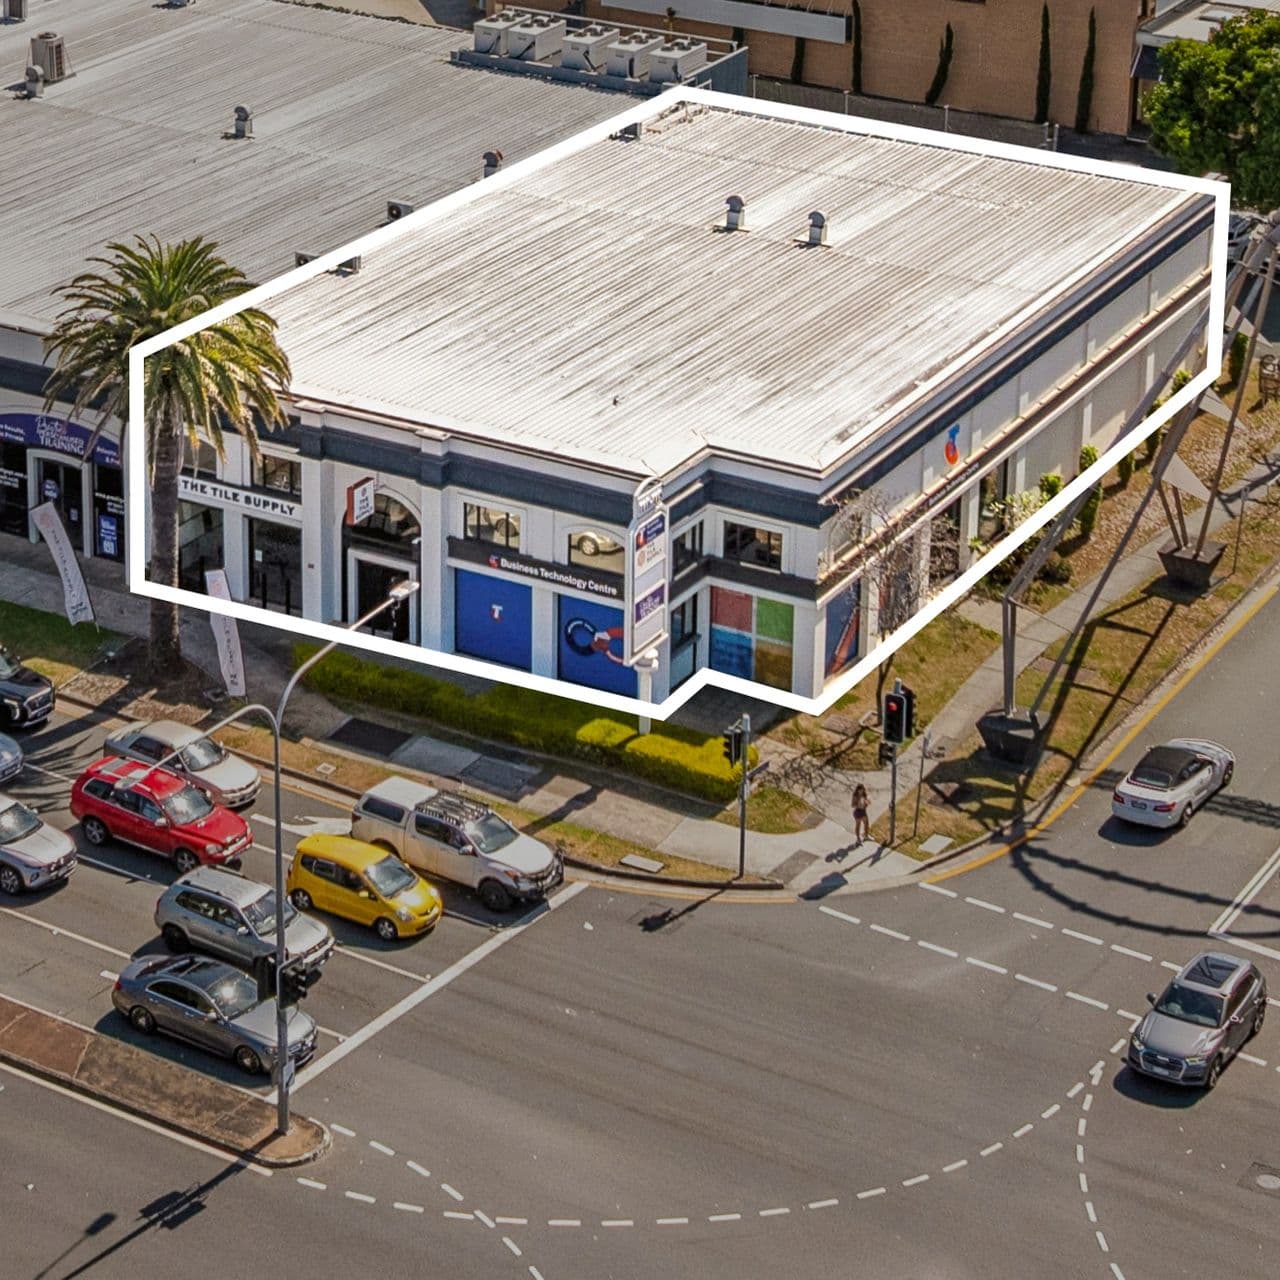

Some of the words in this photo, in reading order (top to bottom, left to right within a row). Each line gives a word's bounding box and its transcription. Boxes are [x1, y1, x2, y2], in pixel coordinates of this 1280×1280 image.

[181, 479, 208, 495] THE
[211, 487, 240, 503] TILE
[244, 494, 295, 516] SUPPLY
[500, 558, 539, 576] Business
[540, 567, 587, 590] Technology
[587, 580, 618, 595] Centre
